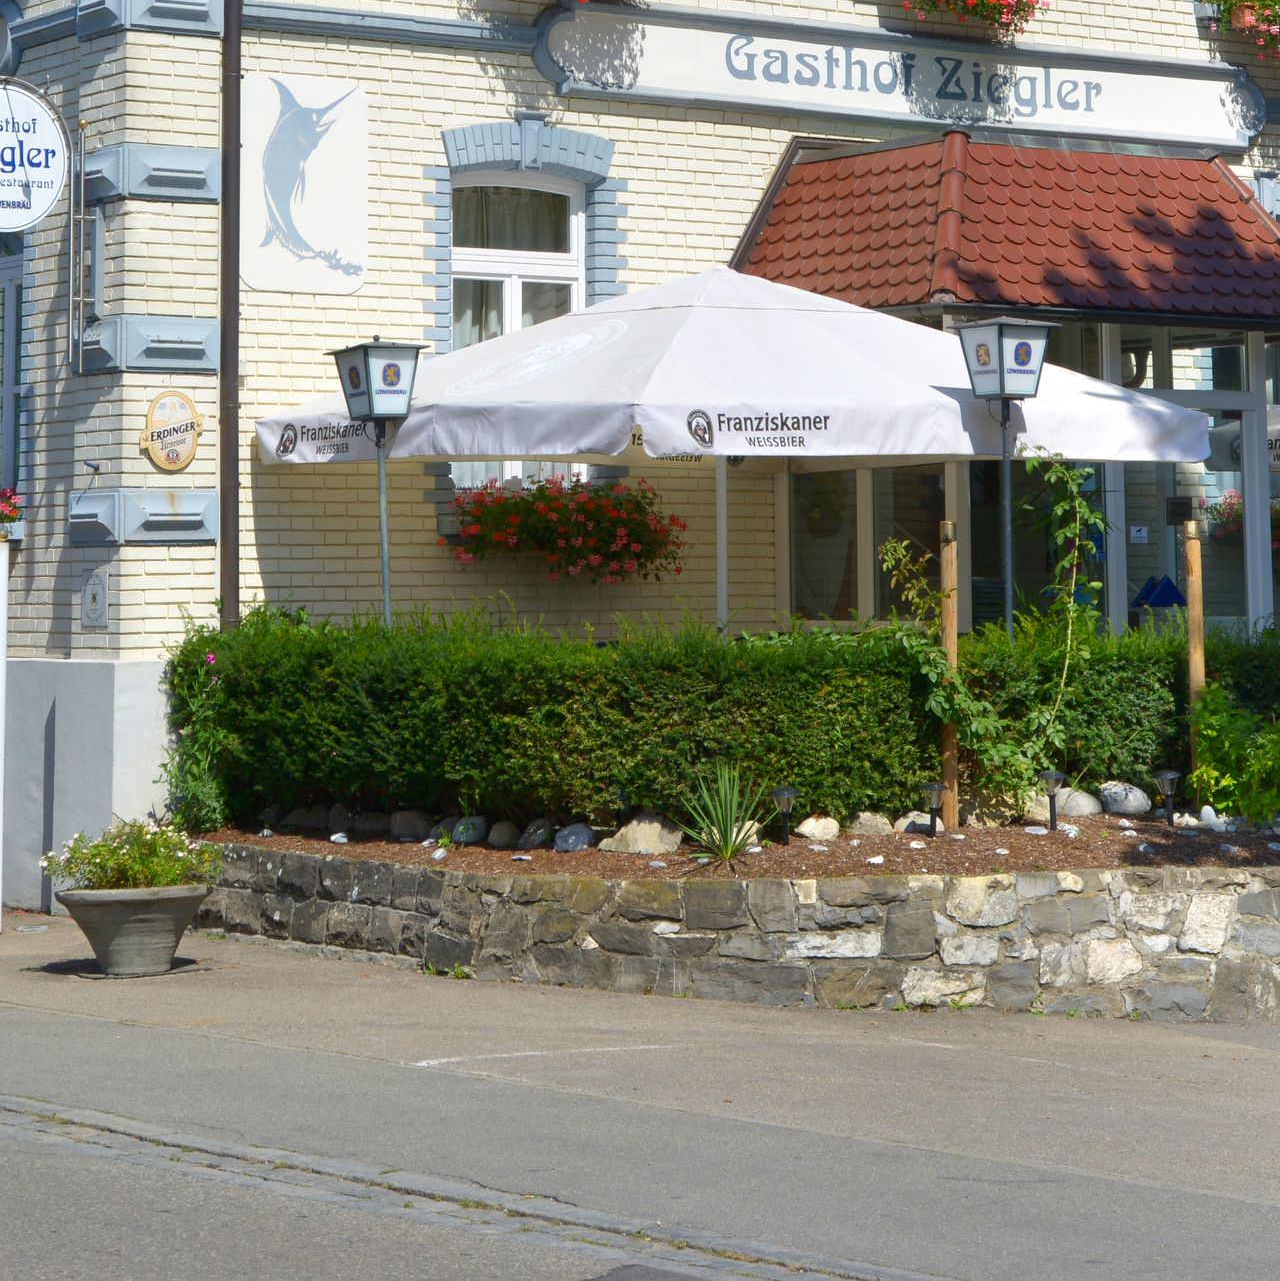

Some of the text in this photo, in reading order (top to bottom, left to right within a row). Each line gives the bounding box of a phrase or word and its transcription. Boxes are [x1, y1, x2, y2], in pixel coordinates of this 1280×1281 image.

[725, 34, 1103, 118] Gasthof Ziegler
[150, 421, 197, 443] ERDINGER
[300, 422, 367, 442] Franziskaner
[716, 412, 831, 433] Franziskaner
[315, 442, 350, 455] WEISSBIER
[745, 436, 807, 448] WEISSBIER
